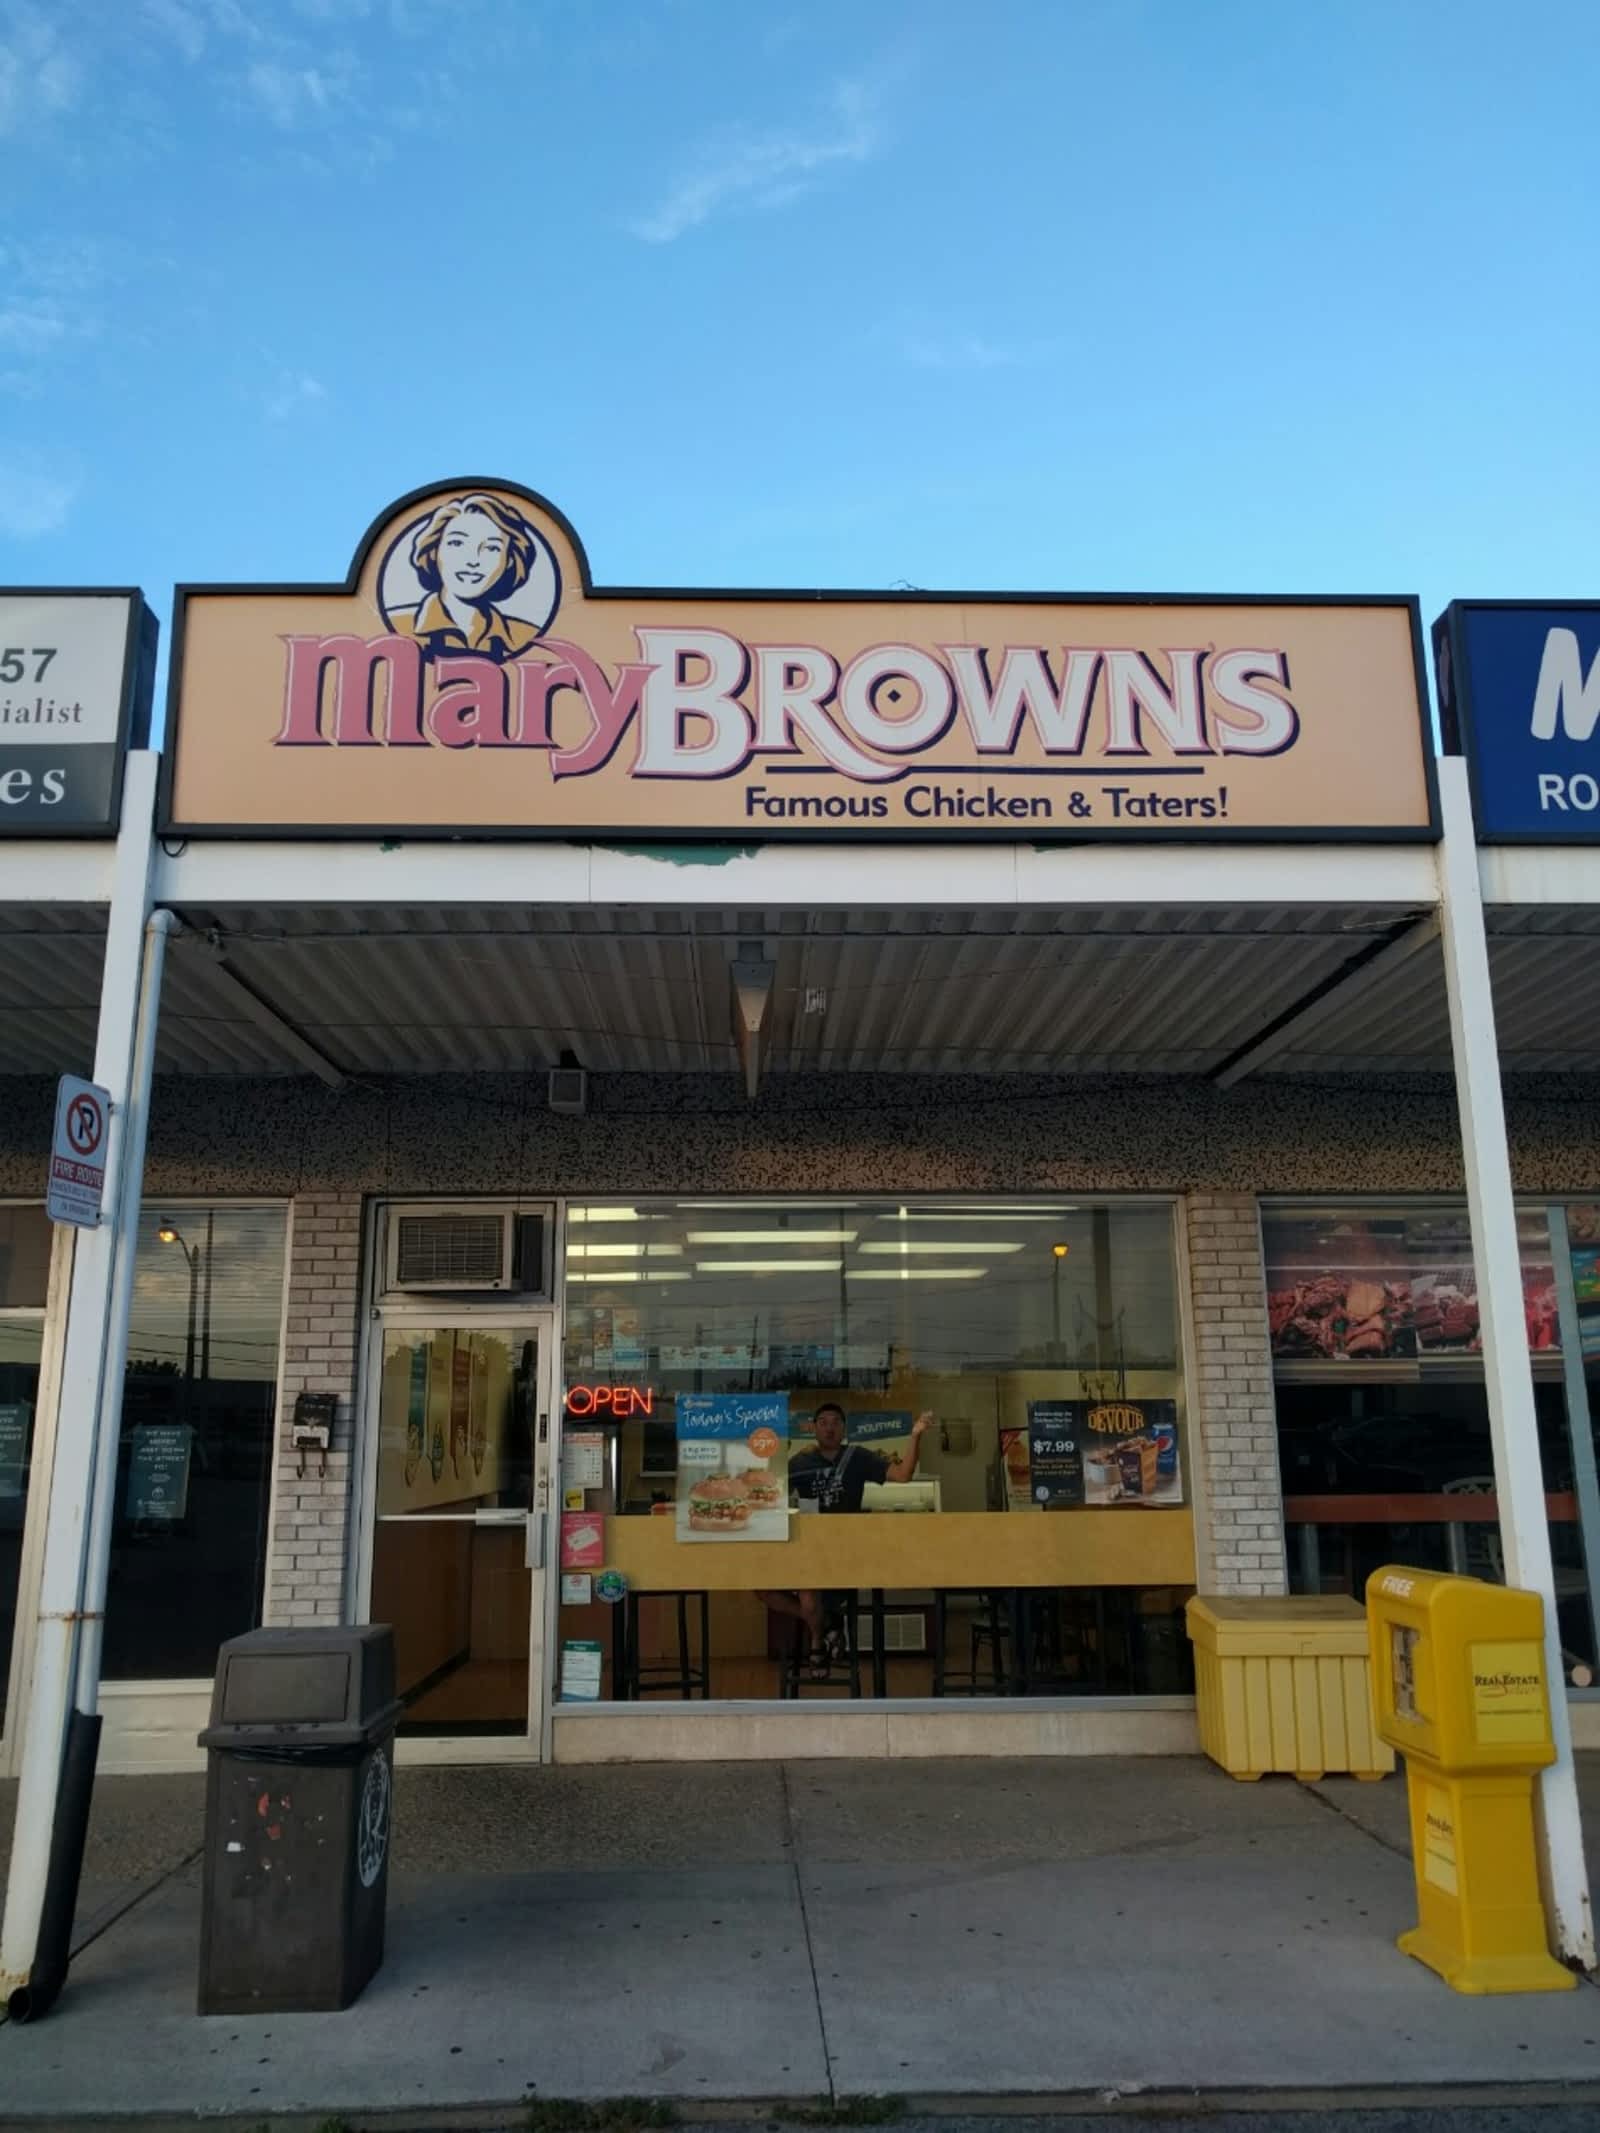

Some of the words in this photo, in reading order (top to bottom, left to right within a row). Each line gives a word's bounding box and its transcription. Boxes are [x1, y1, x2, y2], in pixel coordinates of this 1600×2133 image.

[0, 647, 57, 683] 57
[0, 768, 66, 804] es
[1538, 773, 1600, 811] RO
[745, 786, 889, 818] Famous
[904, 785, 1052, 818] Chicken
[1069, 789, 1092, 818] &
[1102, 786, 1229, 819] Taters!
[55, 1159, 75, 1179] FIRE
[566, 1386, 654, 1415] OPEN
[683, 1408, 734, 1433] Today's
[736, 1404, 780, 1430] Special
[857, 1418, 902, 1435] POUTINE
[1088, 1407, 1145, 1434] DEVOUR
[1033, 1440, 1076, 1456] $7.99
[1382, 1575, 1416, 1598] FREE
